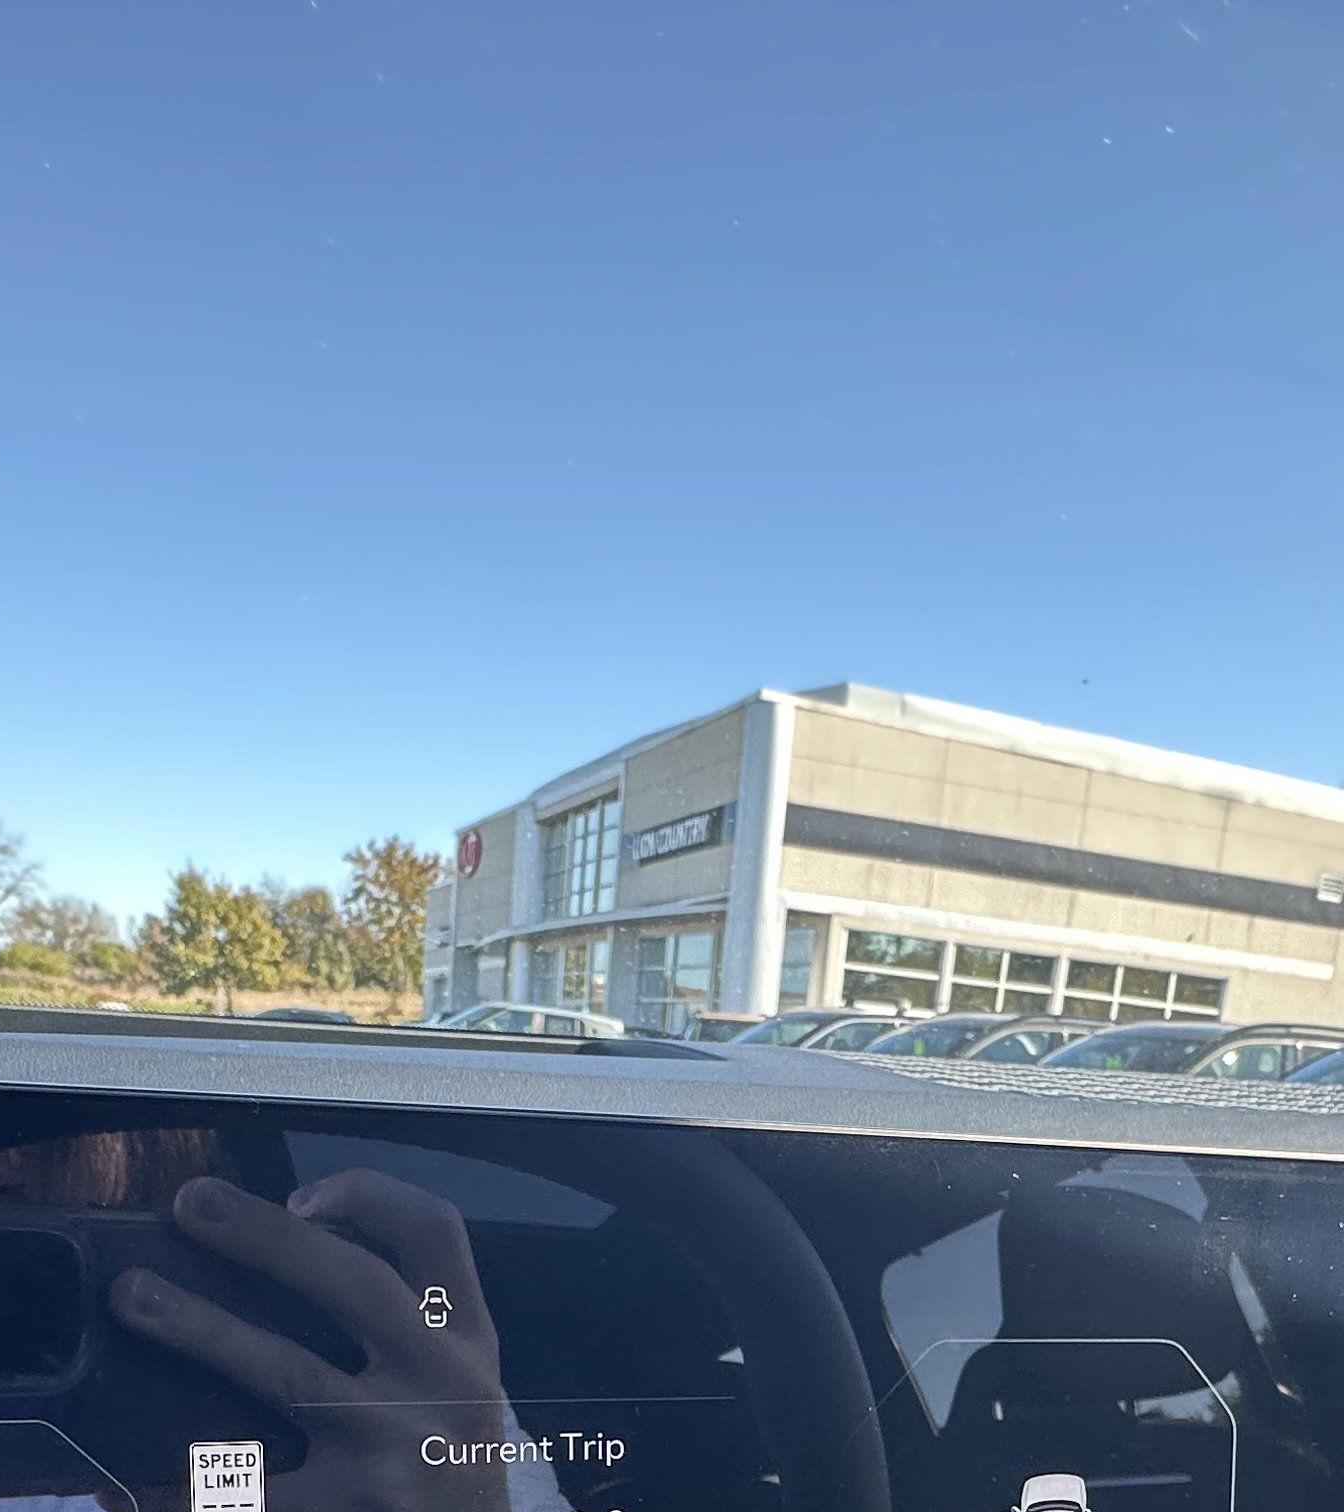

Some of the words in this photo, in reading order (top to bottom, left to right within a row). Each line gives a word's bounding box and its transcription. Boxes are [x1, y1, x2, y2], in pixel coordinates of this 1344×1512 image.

[420, 1433, 554, 1466] Current
[559, 1432, 626, 1469] Trip
[197, 1452, 257, 1470] SPEED
[203, 1472, 253, 1490] LIMIT
